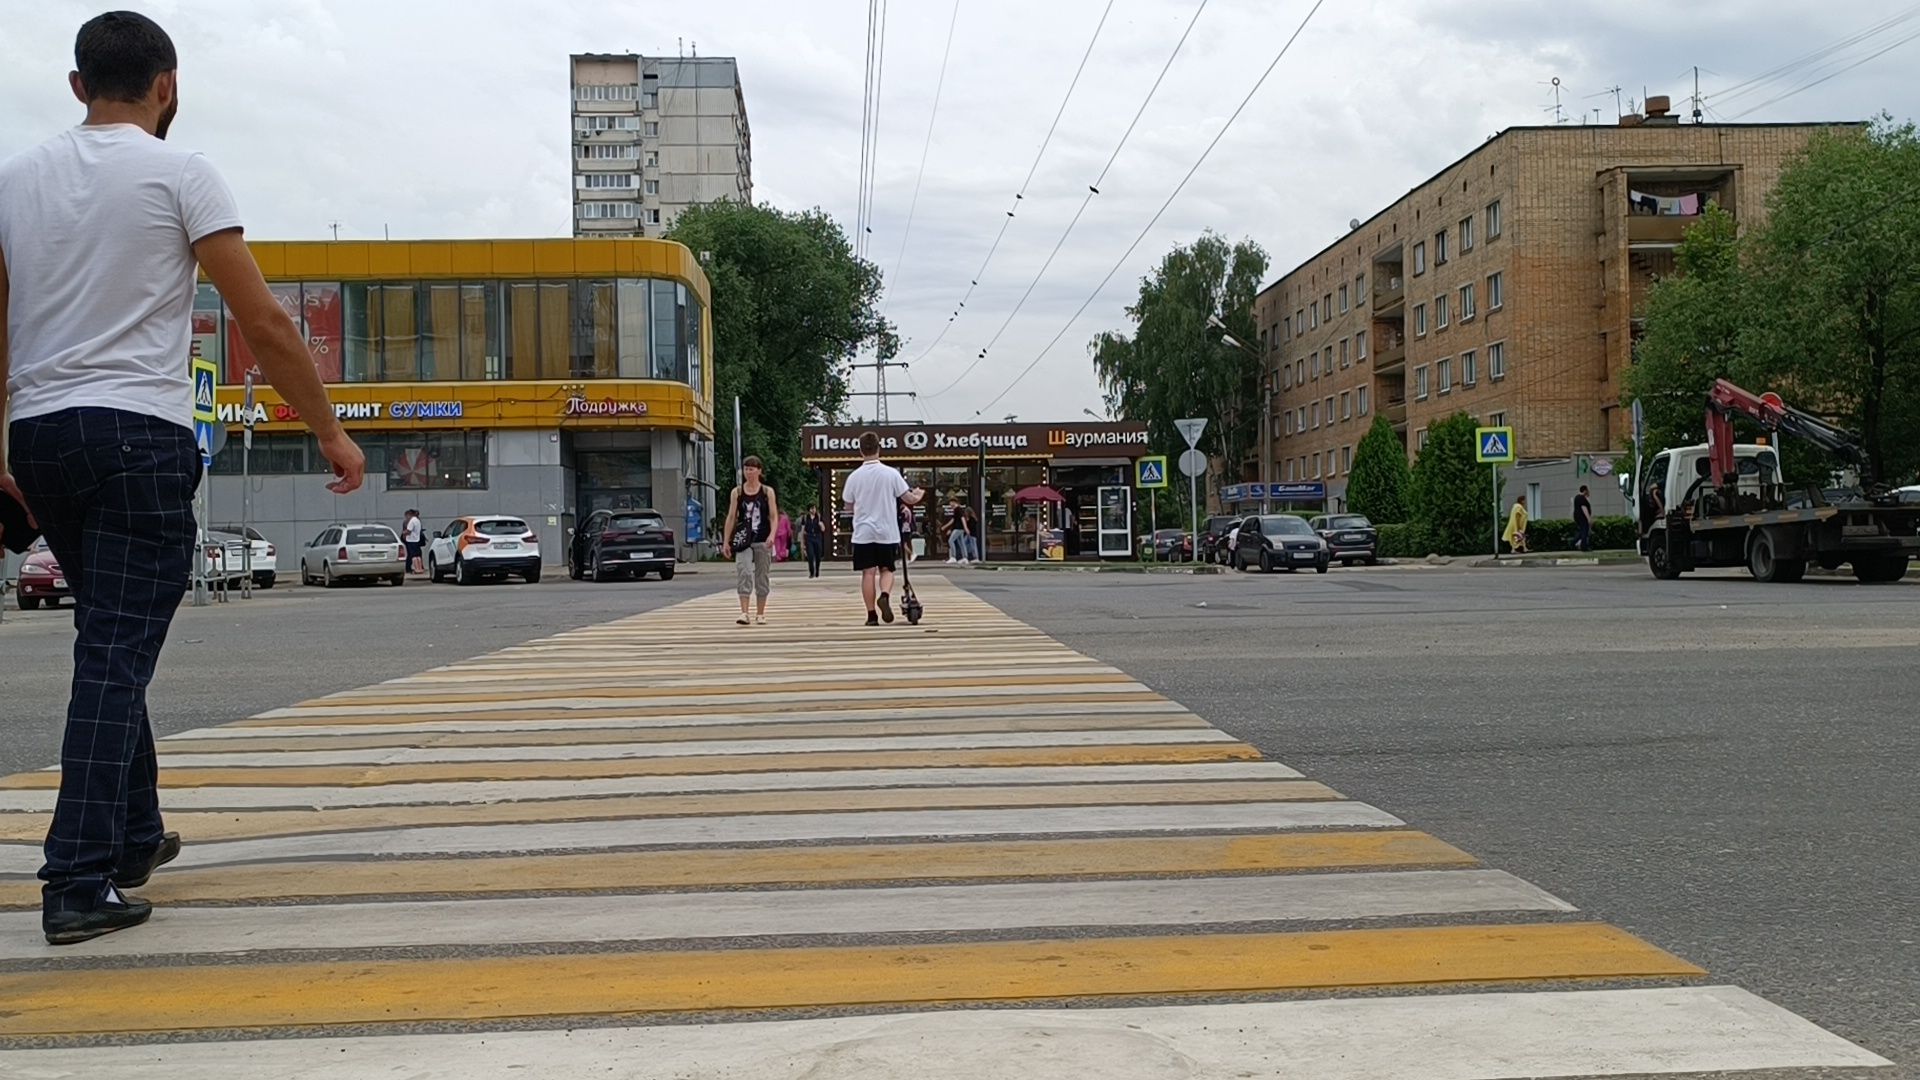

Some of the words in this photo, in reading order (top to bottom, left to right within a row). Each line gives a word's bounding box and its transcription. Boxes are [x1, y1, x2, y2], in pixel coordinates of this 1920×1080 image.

[389, 400, 463, 417] СУМКИ
[566, 396, 647, 415] Подружка
[814, 434, 898, 450] Пеканя
[934, 432, 1028, 449] Хлебница
[1048, 430, 1149, 448] Шаурмания
